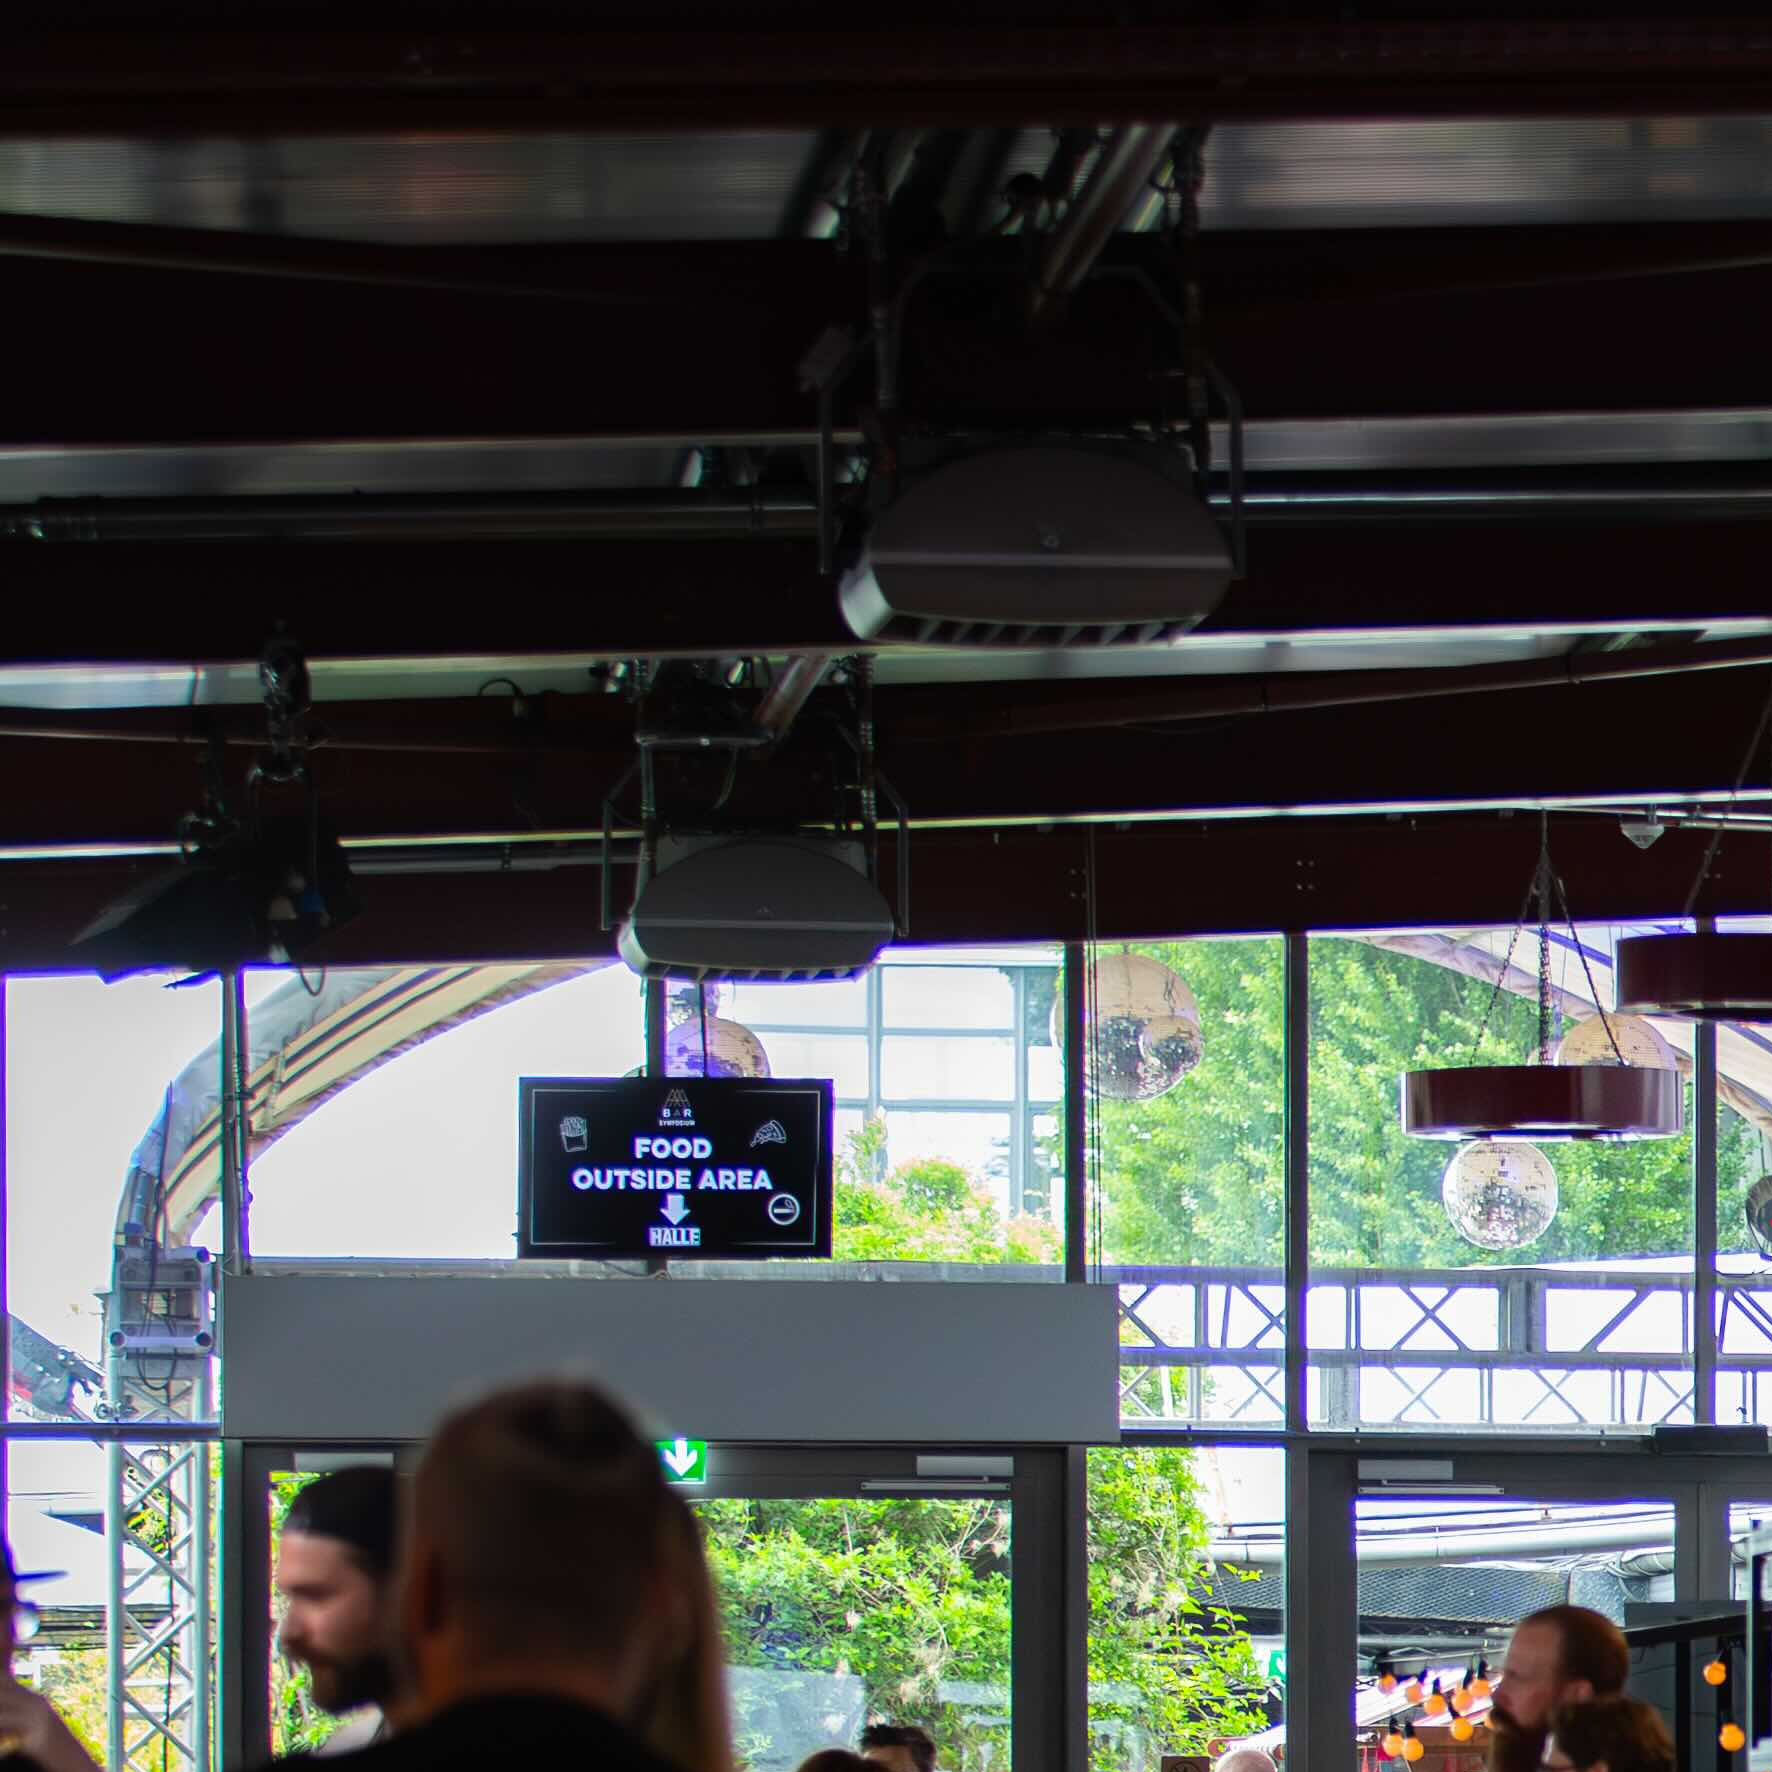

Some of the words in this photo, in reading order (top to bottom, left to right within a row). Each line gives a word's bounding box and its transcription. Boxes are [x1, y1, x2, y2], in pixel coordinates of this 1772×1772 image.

[634, 1137, 713, 1160] FOOD
[572, 1168, 692, 1191] OUTSIDE
[698, 1168, 773, 1191] AREA
[649, 1226, 702, 1247] HALLE
